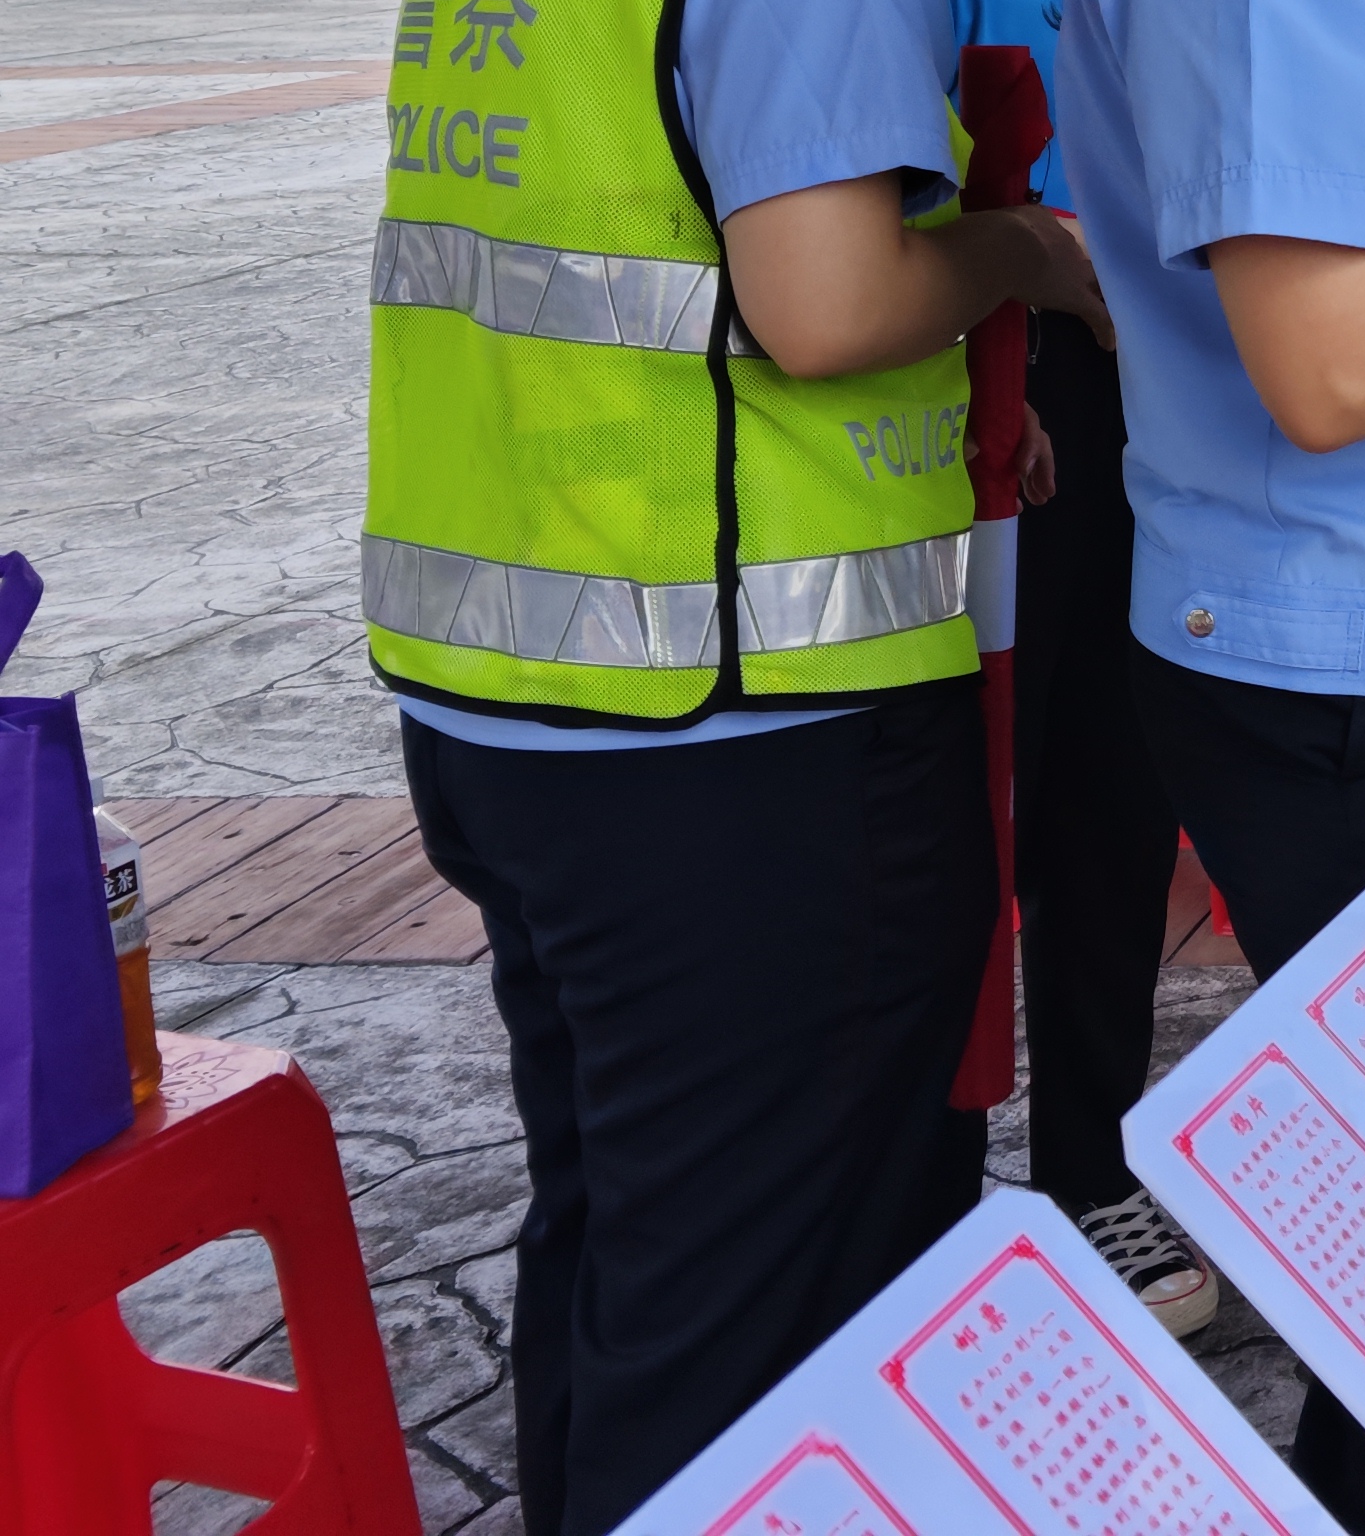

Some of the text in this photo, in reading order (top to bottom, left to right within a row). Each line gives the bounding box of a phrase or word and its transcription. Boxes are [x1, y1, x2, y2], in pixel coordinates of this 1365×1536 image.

[843, 402, 967, 481] POLICE
[1229, 1094, 1268, 1135] 鸦片
[952, 1301, 1007, 1352] 邮票
